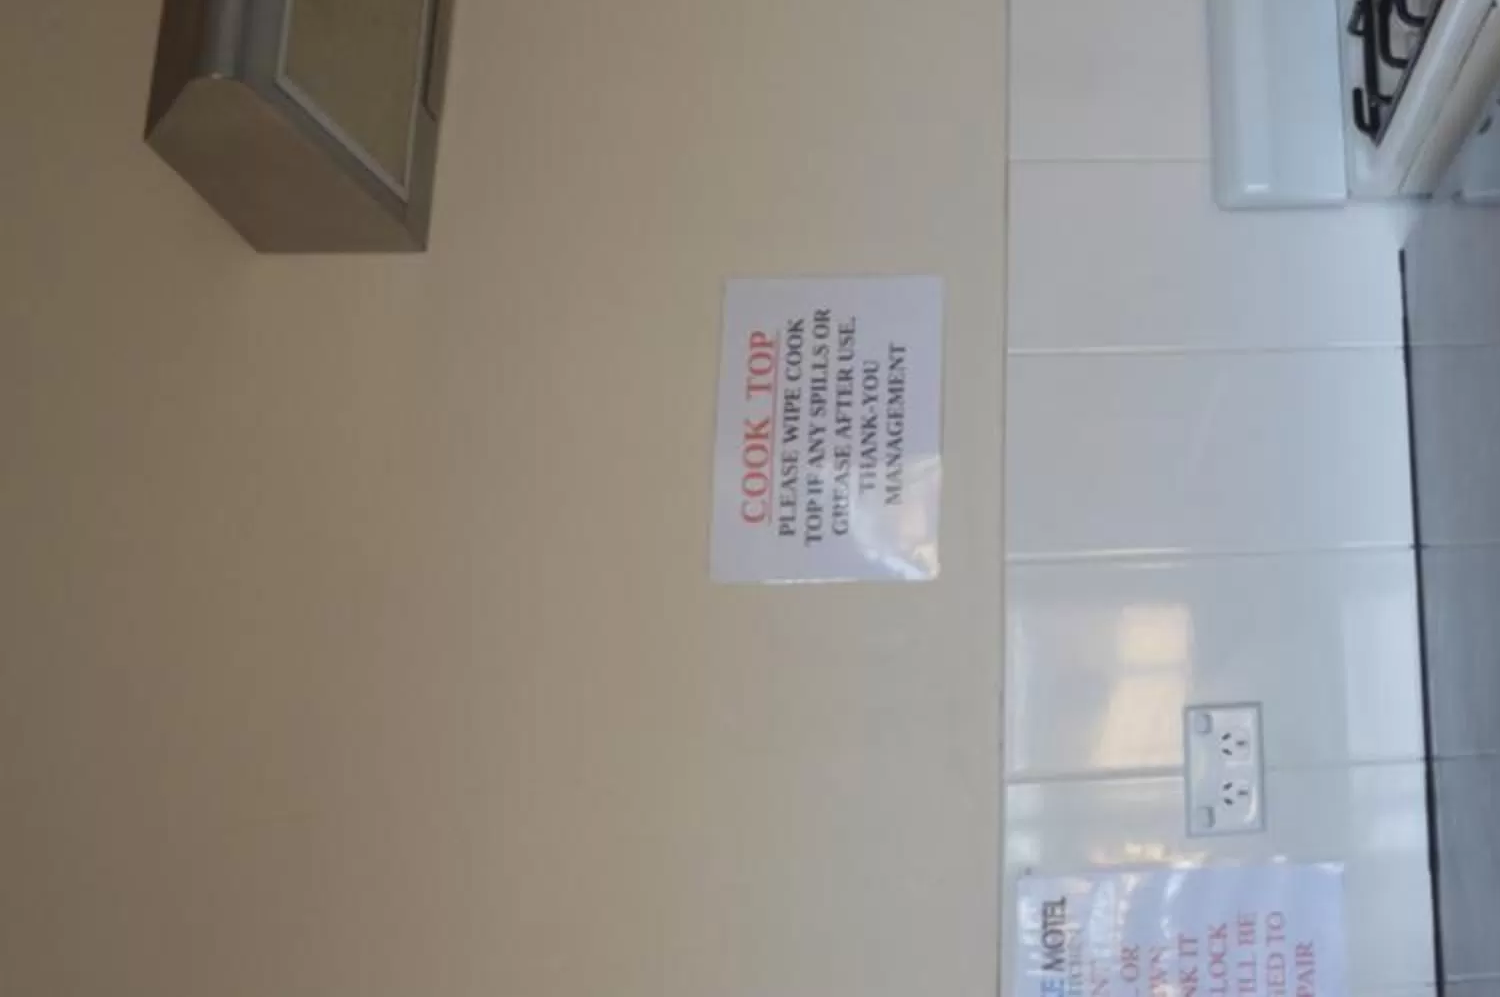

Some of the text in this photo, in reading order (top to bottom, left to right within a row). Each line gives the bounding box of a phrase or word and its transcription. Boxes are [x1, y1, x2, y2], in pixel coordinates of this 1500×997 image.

[740, 330, 775, 524] COOK TOP
[777, 318, 804, 537] PLEASE WIPE COOK
[804, 308, 831, 546] TOP IF ANY SPILLS OR
[831, 315, 857, 535] GREASE AFTER USE.
[859, 360, 879, 495] THANK-YOU
[883, 342, 906, 507] MANAGEMENT
[1041, 896, 1067, 997] E MOTEL
[1119, 943, 1140, 983] OR
[1177, 932, 1199, 958] IT
[1237, 910, 1258, 997] ILL BE
[1265, 910, 1288, 947] TO
